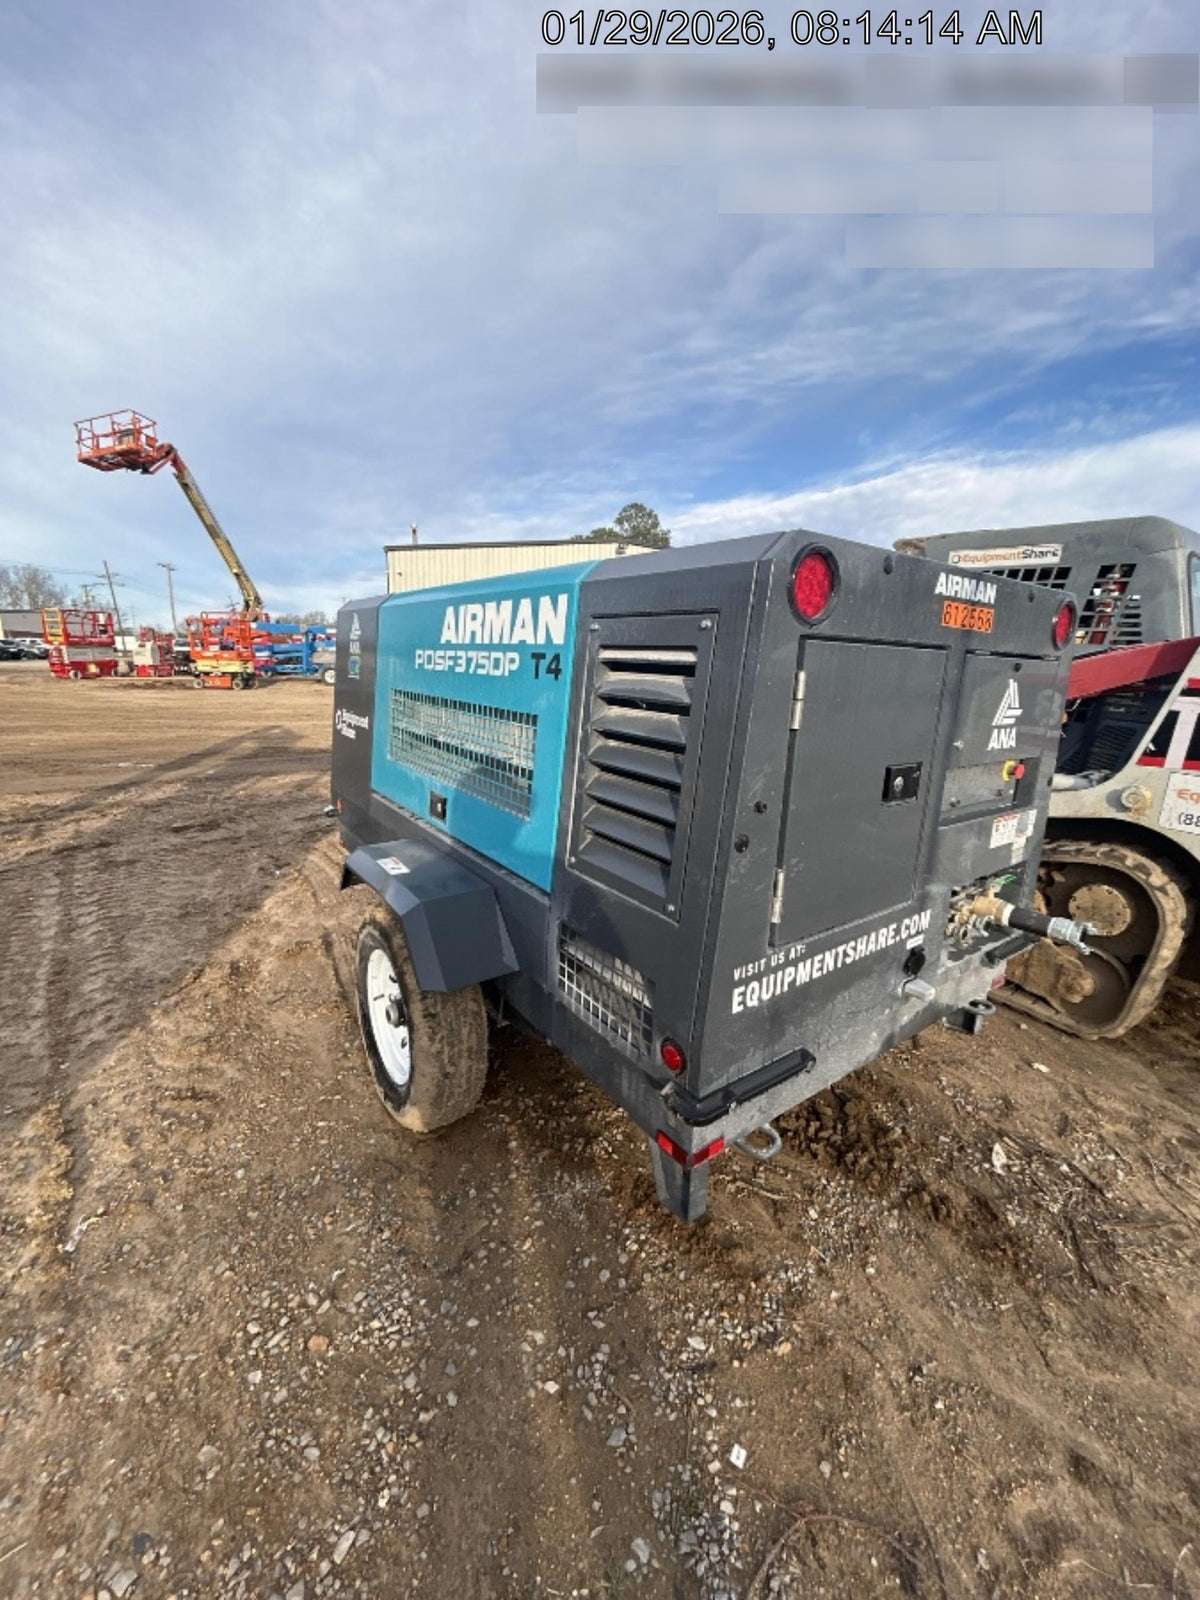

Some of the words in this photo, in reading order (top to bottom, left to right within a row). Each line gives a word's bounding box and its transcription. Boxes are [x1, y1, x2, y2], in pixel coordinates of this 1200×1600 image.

[934, 571, 997, 604] AIRMAN
[440, 594, 568, 645] AIRMAN
[531, 652, 562, 681] T4
[987, 727, 1016, 751] ANA
[732, 910, 931, 1014] EQUIPMENTSHARE.COM
[733, 959, 767, 981] VISIT
[771, 952, 785, 967] US
[789, 944, 806, 961] AT:
